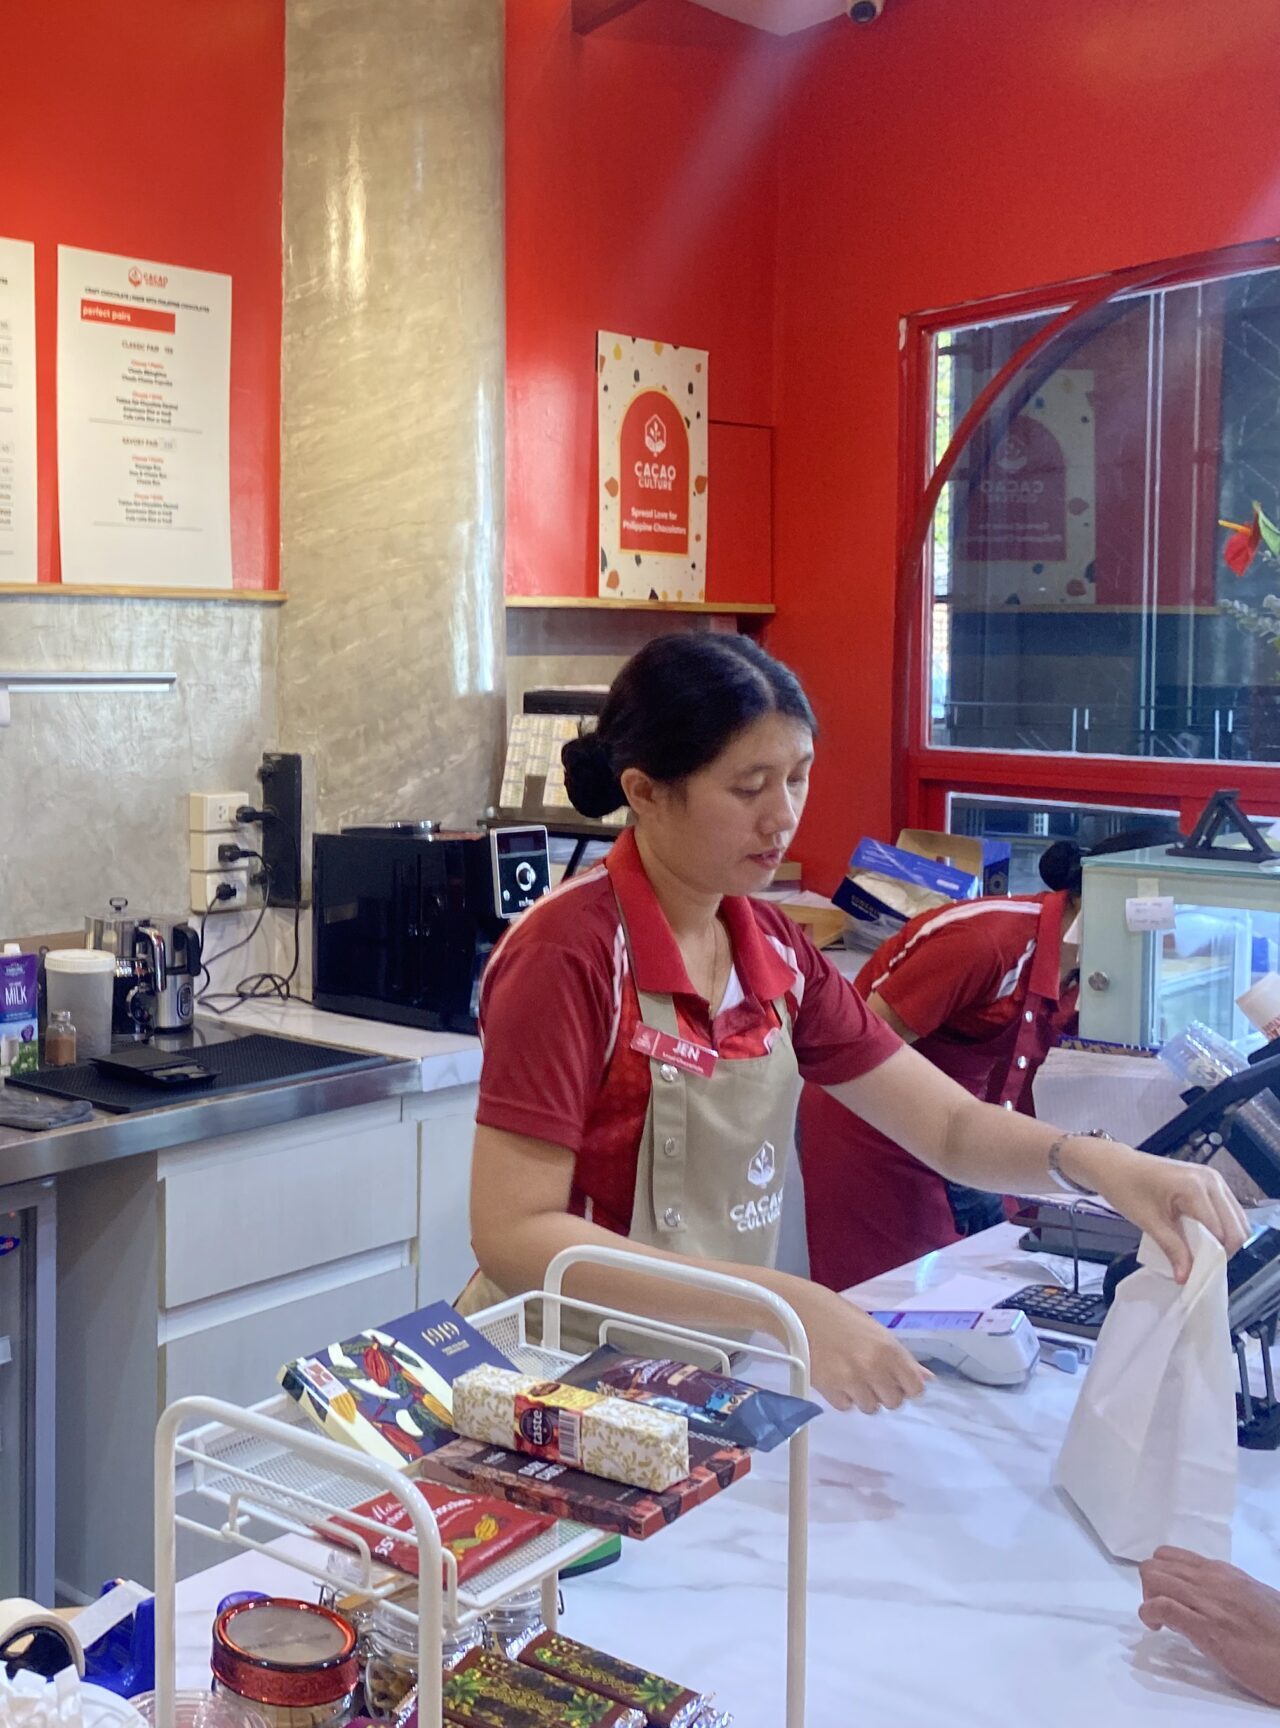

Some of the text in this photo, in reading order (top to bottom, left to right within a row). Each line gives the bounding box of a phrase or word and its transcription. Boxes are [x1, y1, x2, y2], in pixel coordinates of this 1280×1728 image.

[634, 461, 676, 480] CACAO
[639, 479, 672, 490] CULTURE
[631, 506, 677, 520] Spread Love for
[623, 520, 653, 534] Philippine
[5, 986, 27, 1006] MILK
[673, 1040, 700, 1062] JEN
